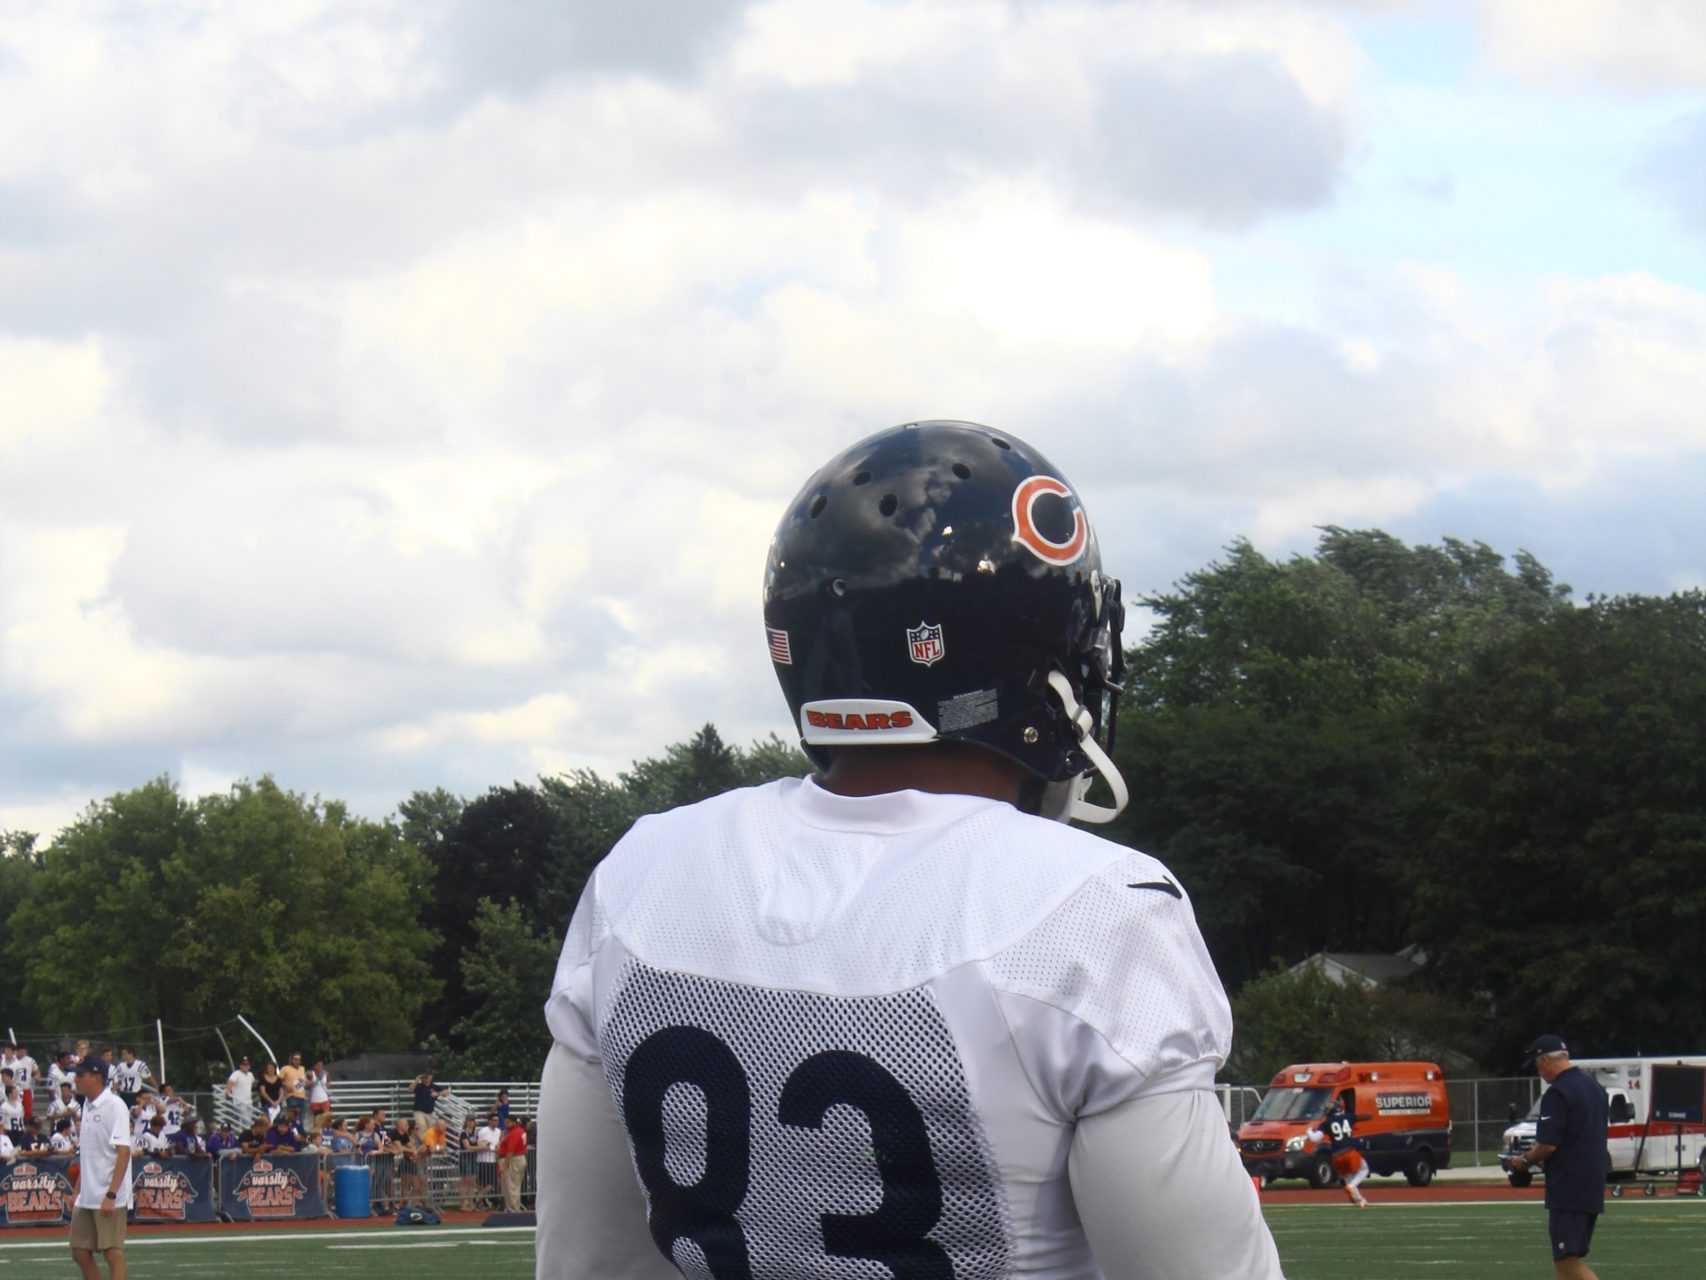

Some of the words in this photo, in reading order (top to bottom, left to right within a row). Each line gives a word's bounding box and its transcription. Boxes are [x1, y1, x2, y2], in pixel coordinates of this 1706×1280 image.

[1011, 475, 1087, 566] C
[914, 642, 940, 659] NFL
[806, 710, 914, 730] BEARS
[124, 1077, 136, 1092] 17
[1628, 1080, 1641, 1090] 14
[1376, 1095, 1432, 1109] SUPERIOR
[1331, 1119, 1352, 1141] 94
[7, 1190, 61, 1212] BEARS
[136, 1188, 184, 1209] BEARS
[248, 1186, 294, 1207] BEARS
